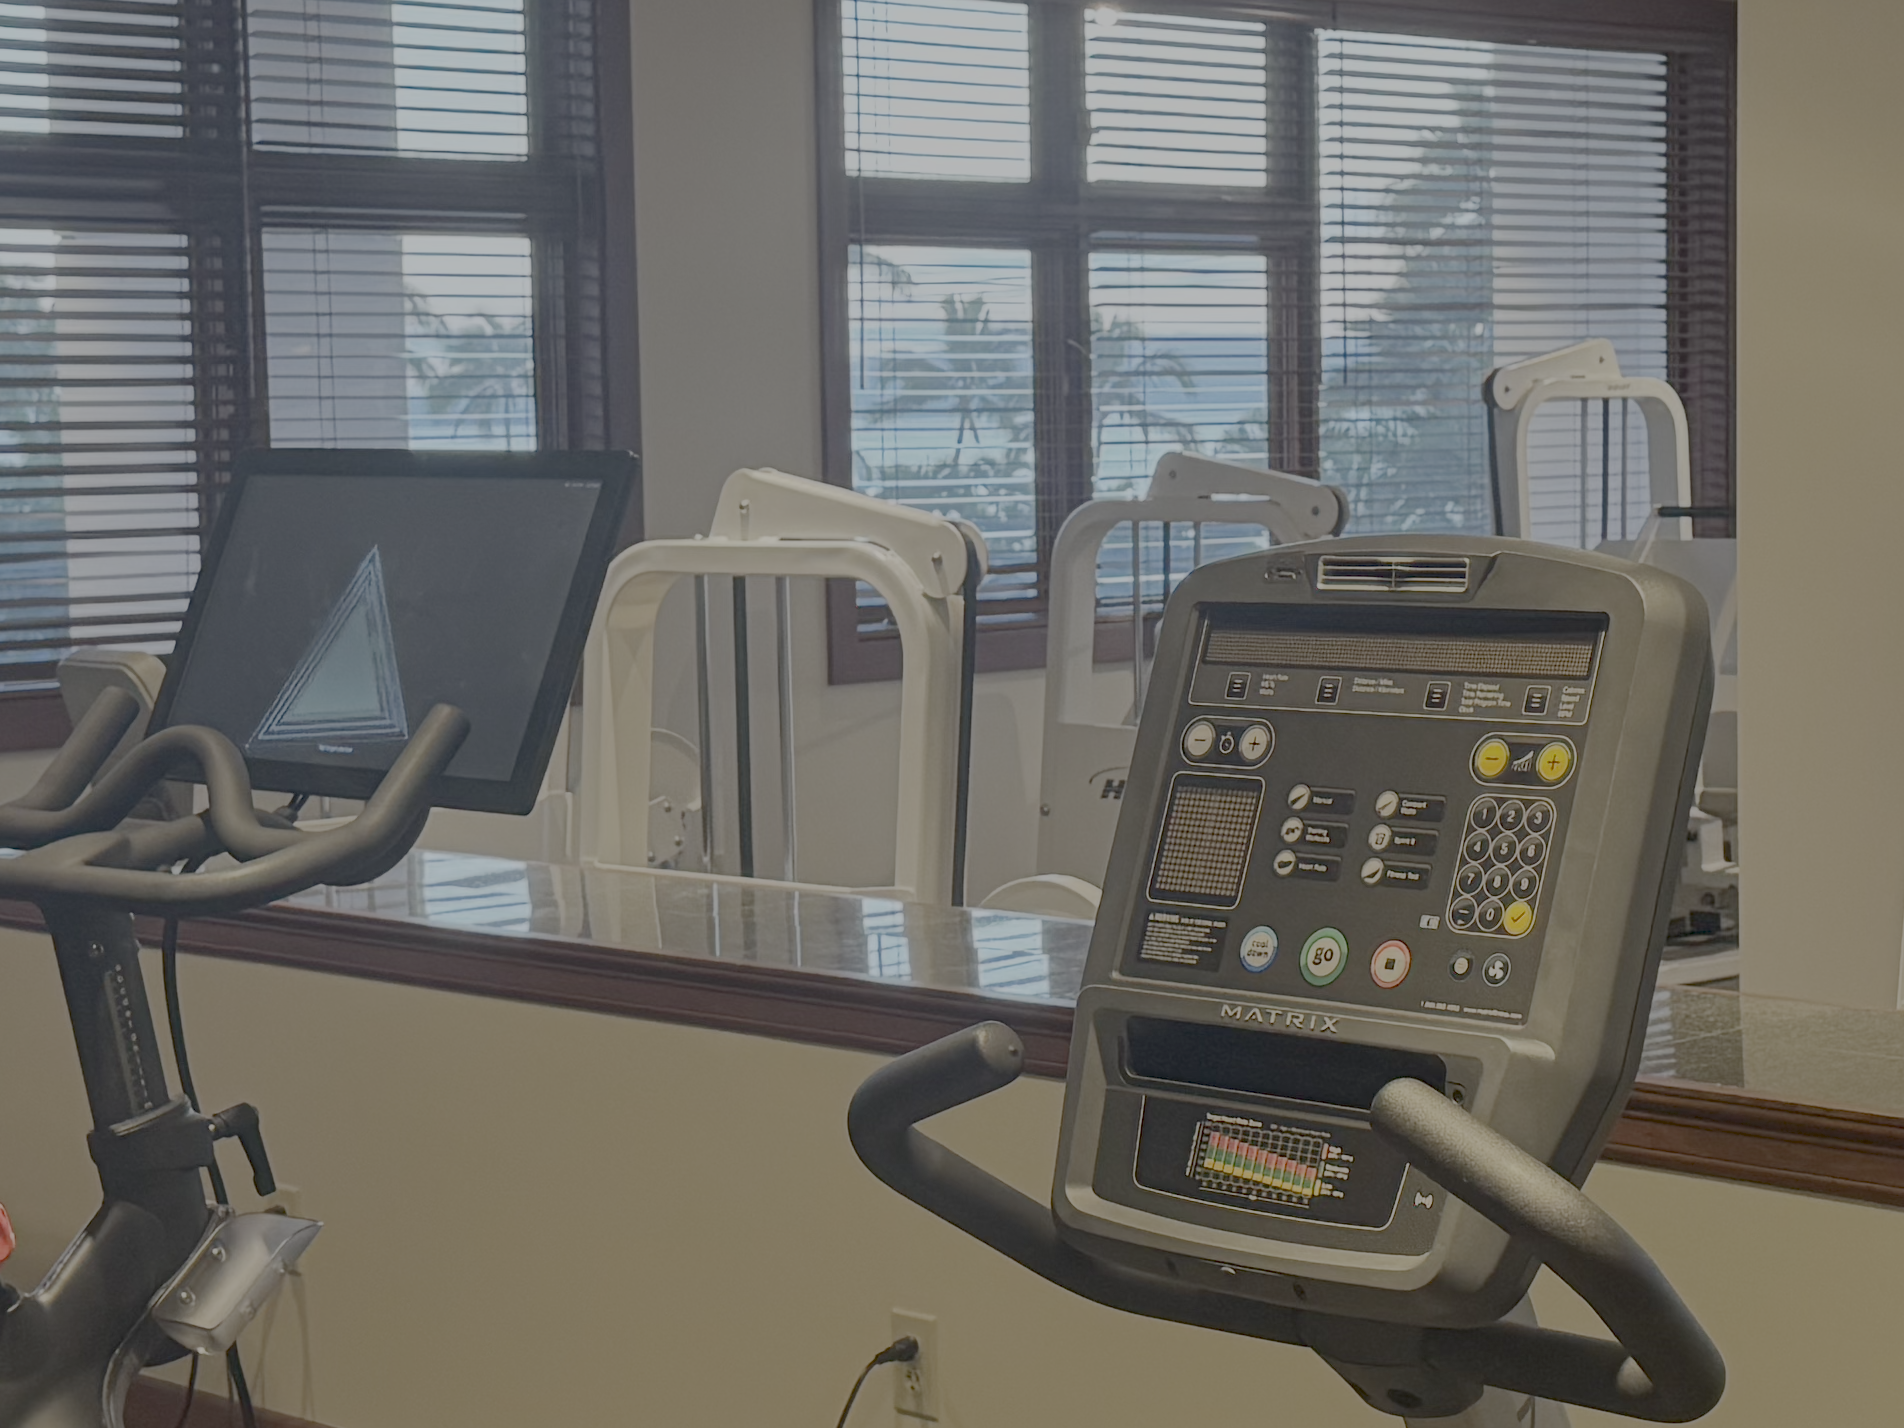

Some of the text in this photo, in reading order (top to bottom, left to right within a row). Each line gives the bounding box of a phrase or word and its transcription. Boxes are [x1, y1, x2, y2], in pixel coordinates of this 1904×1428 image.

[1482, 808, 1543, 824] 1 2 3
[1473, 841, 1536, 857] 4 5 6
[1467, 873, 1529, 891] 7 8 9
[1486, 908, 1495, 920] 0
[1312, 946, 1334, 966] go
[1220, 1004, 1339, 1034] MATRIX
